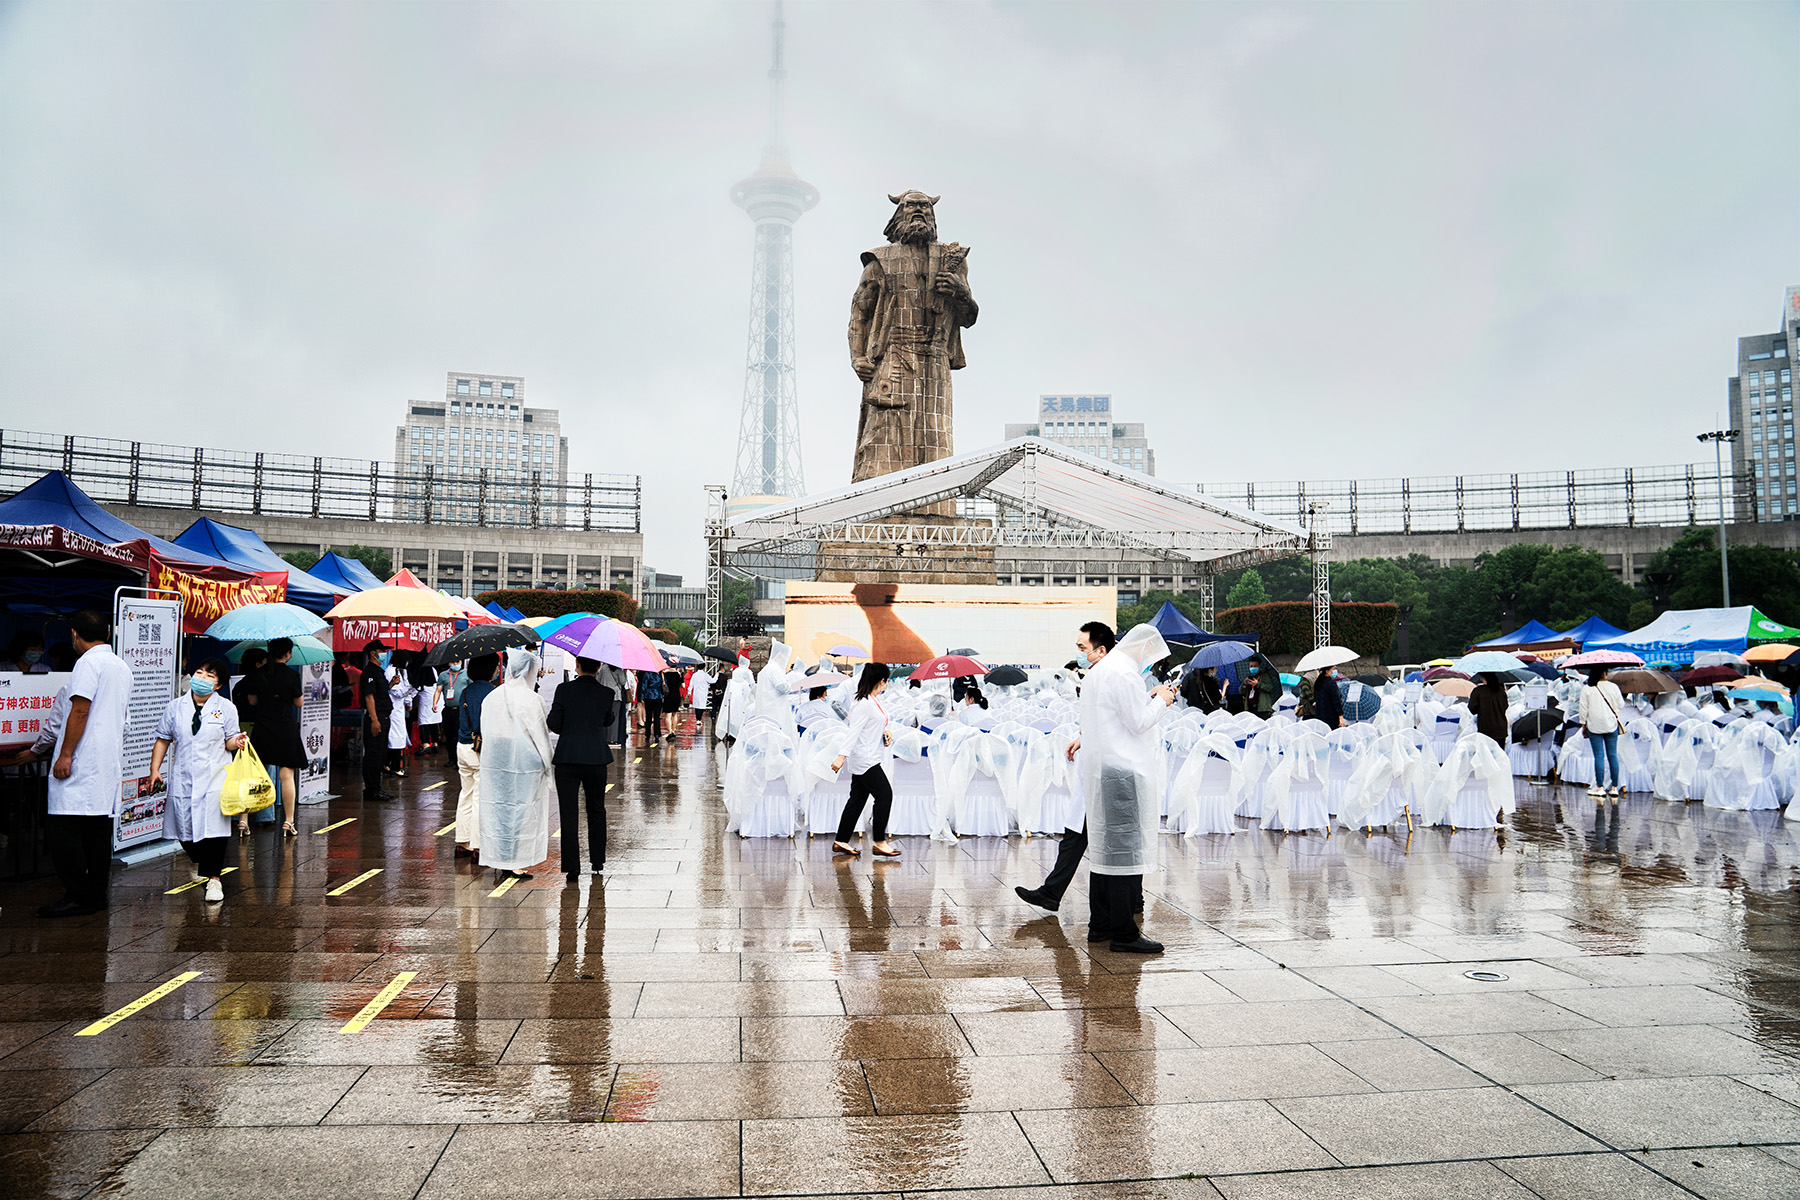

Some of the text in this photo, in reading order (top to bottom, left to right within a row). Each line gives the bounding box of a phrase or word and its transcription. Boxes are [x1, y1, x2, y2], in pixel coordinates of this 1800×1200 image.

[1042, 397, 1109, 412] 天易集团
[0, 696, 56, 710] 方神农道地
